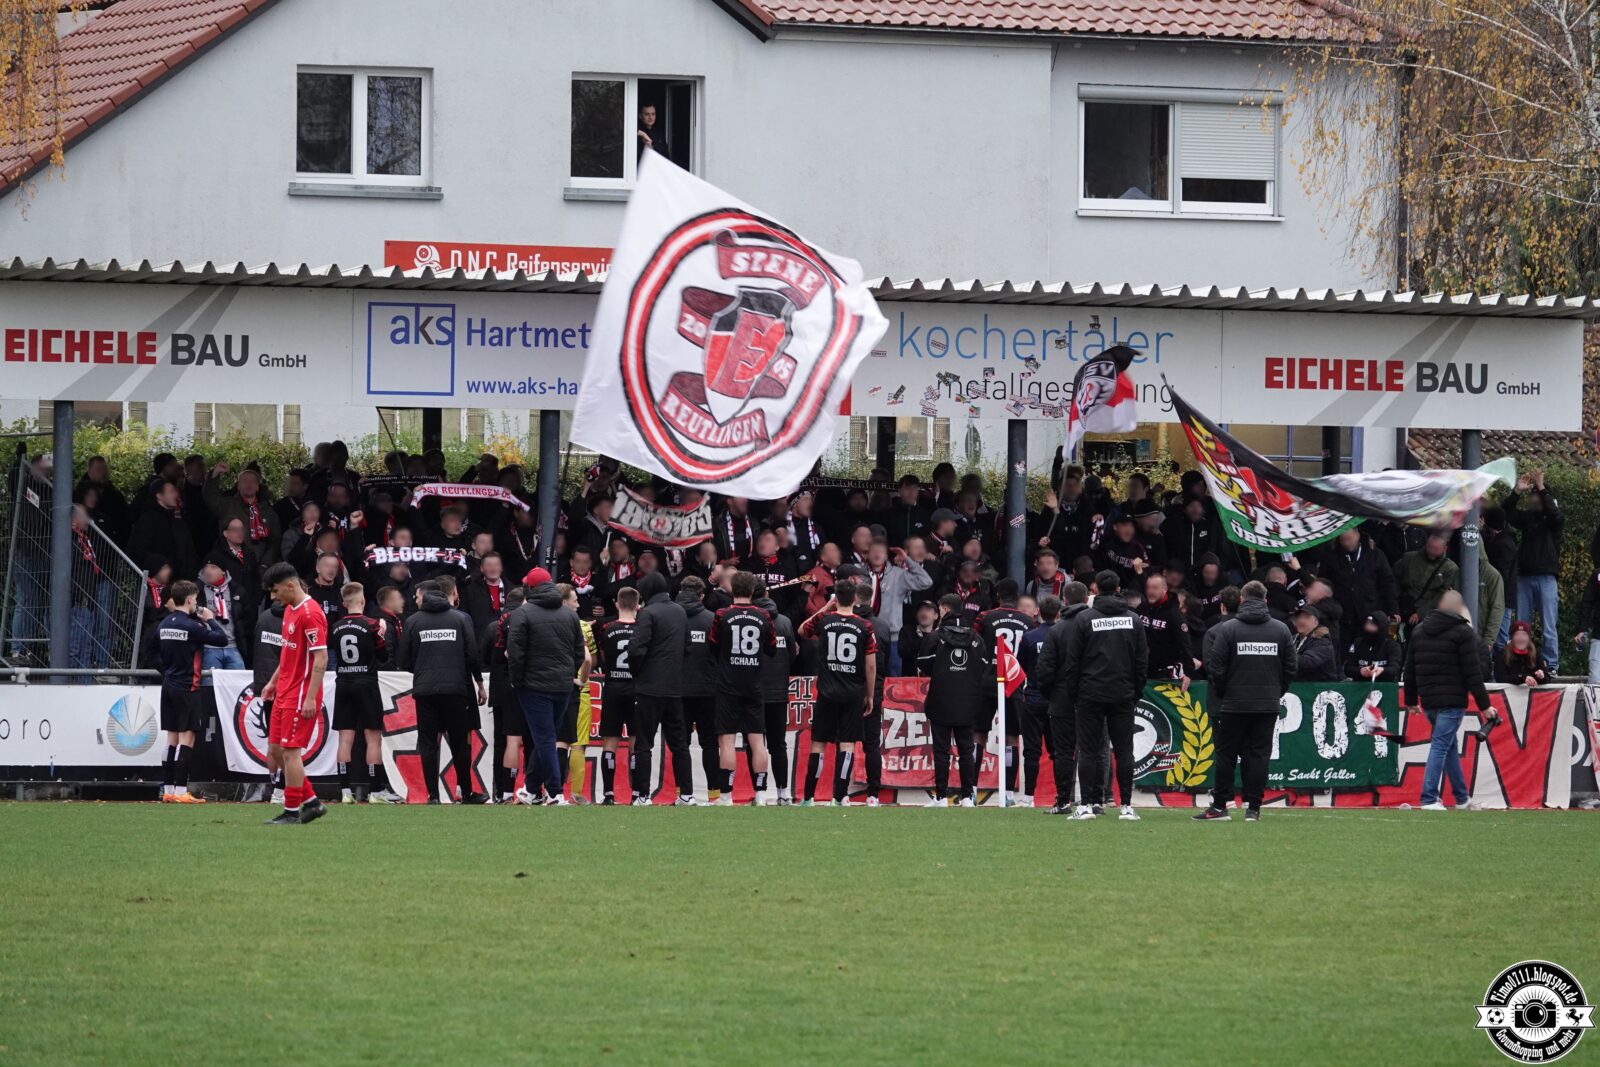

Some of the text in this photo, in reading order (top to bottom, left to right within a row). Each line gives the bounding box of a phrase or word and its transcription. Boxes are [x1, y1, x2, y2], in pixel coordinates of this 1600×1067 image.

[389, 312, 453, 346] aks
[899, 311, 1174, 364] kochertaler
[4, 328, 307, 368] EICHELE BAU GmbH
[466, 376, 583, 395] www.aks-ha
[1264, 356, 1541, 396] EICHELE BAU GmbH
[662, 396, 763, 446] REUTLINGEN
[442, 486, 499, 497] REUTLINGEN
[373, 546, 440, 565] BLOCK
[1093, 619, 1132, 628] uhlsport
[160, 630, 187, 639] uhlsport
[262, 633, 284, 643] uhlsp
[420, 631, 455, 639] uhlsport
[731, 625, 760, 655] 18
[340, 634, 360, 664] 6
[827, 632, 858, 663] 16
[1238, 643, 1277, 653] uhlsport
[730, 656, 760, 666] SCHAAL
[1288, 767, 1321, 781] Sankt
[1323, 767, 1356, 783] Gallen
